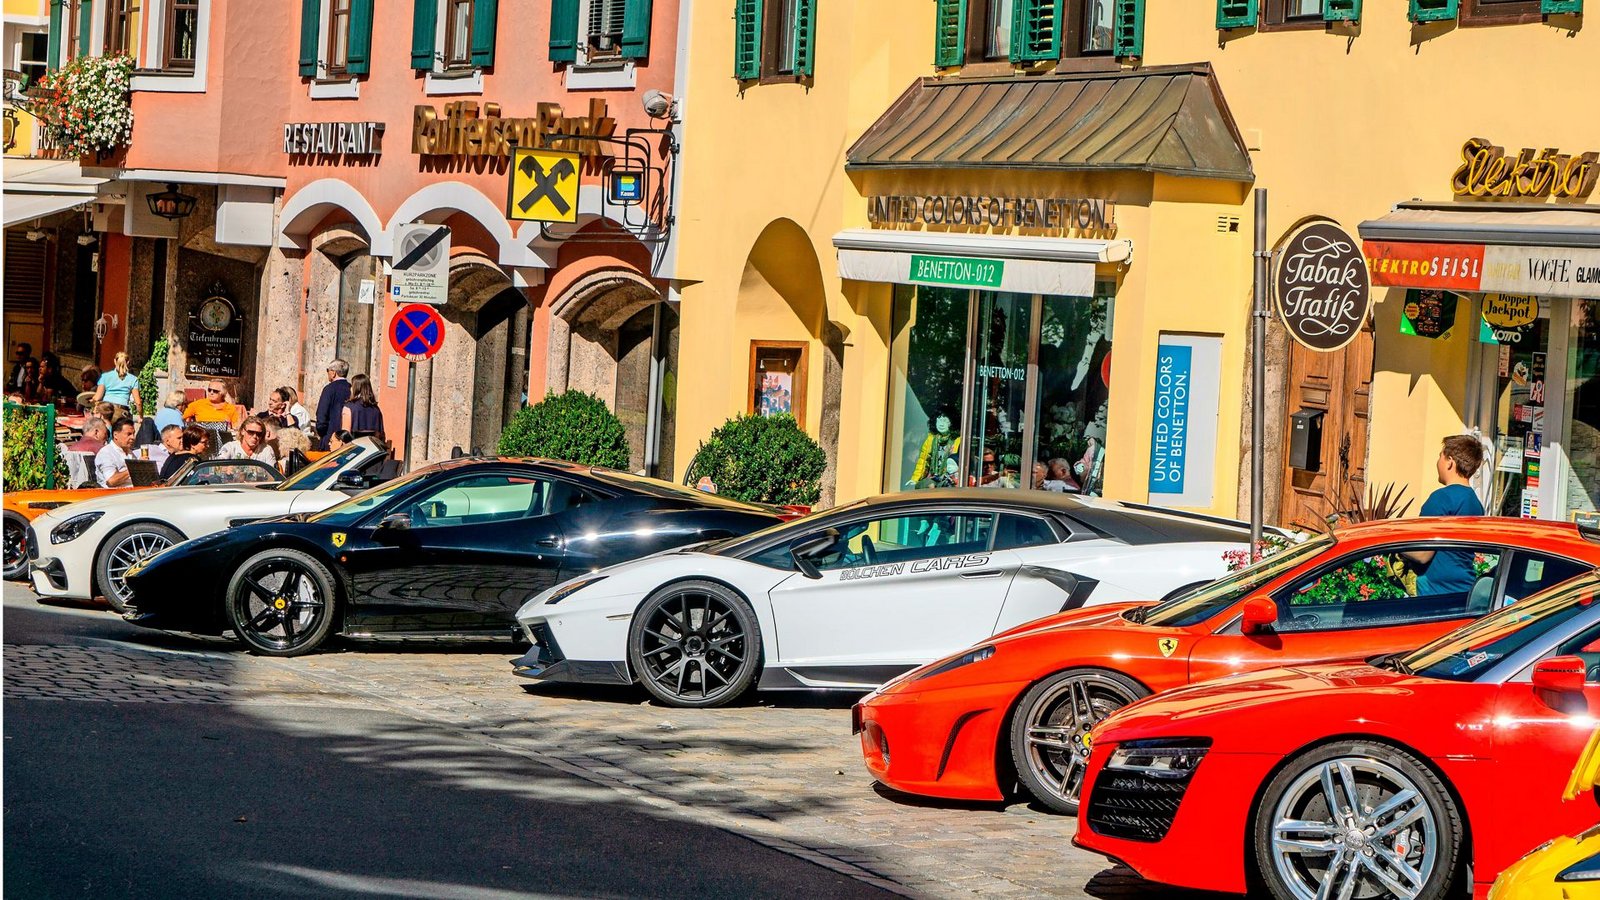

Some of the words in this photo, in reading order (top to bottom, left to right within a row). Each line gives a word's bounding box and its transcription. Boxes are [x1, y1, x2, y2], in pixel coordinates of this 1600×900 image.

[283, 122, 377, 153] RESTAURANT
[1451, 138, 1592, 196] Elektro
[867, 196, 918, 223] UNITED
[922, 196, 982, 225] COLORS
[988, 198, 1016, 227] OF
[917, 260, 995, 283] BENETTON-012
[1285, 244, 1362, 288] Tabak
[1528, 258, 1572, 283] VOGUE
[1284, 286, 1360, 326] Trafik
[1485, 300, 1530, 320] Jackpot
[1498, 293, 1531, 307] Doppel
[1491, 329, 1521, 342] LOTTO
[979, 365, 1025, 380] BENETTON-012
[1157, 356, 1173, 419] COLORS
[1170, 370, 1187, 457] BENETTON.
[1154, 423, 1168, 482] UNITED
[1169, 460, 1182, 482] OF
[910, 552, 993, 573] CARS
